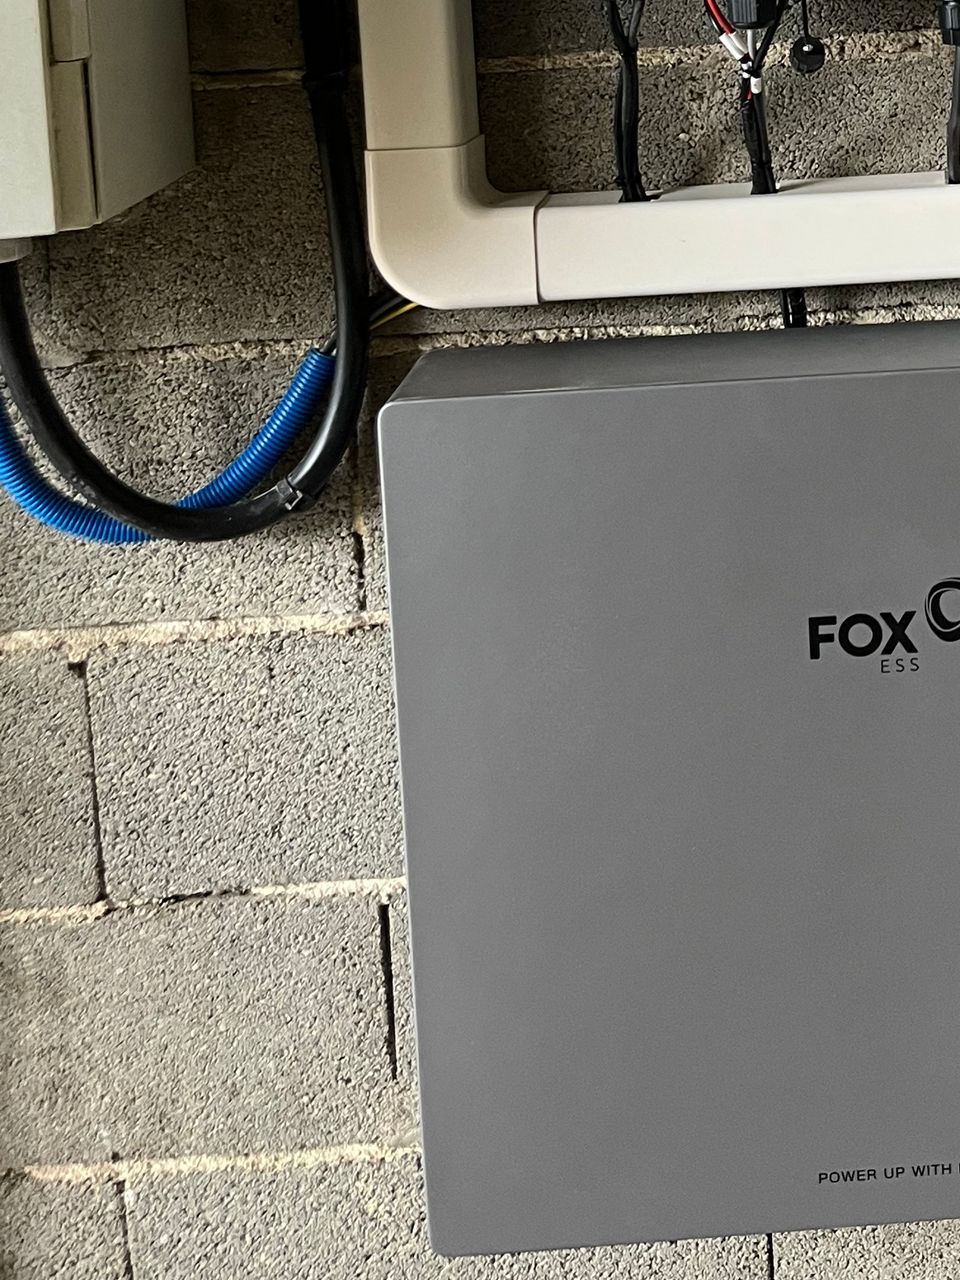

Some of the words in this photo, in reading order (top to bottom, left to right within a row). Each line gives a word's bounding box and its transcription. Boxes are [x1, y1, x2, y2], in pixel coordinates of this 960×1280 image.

[808, 610, 919, 660] FOX
[880, 657, 920, 674] ESS
[818, 1169, 877, 1184] POWER
[883, 1167, 905, 1179] UP
[911, 1163, 952, 1177] WITH
